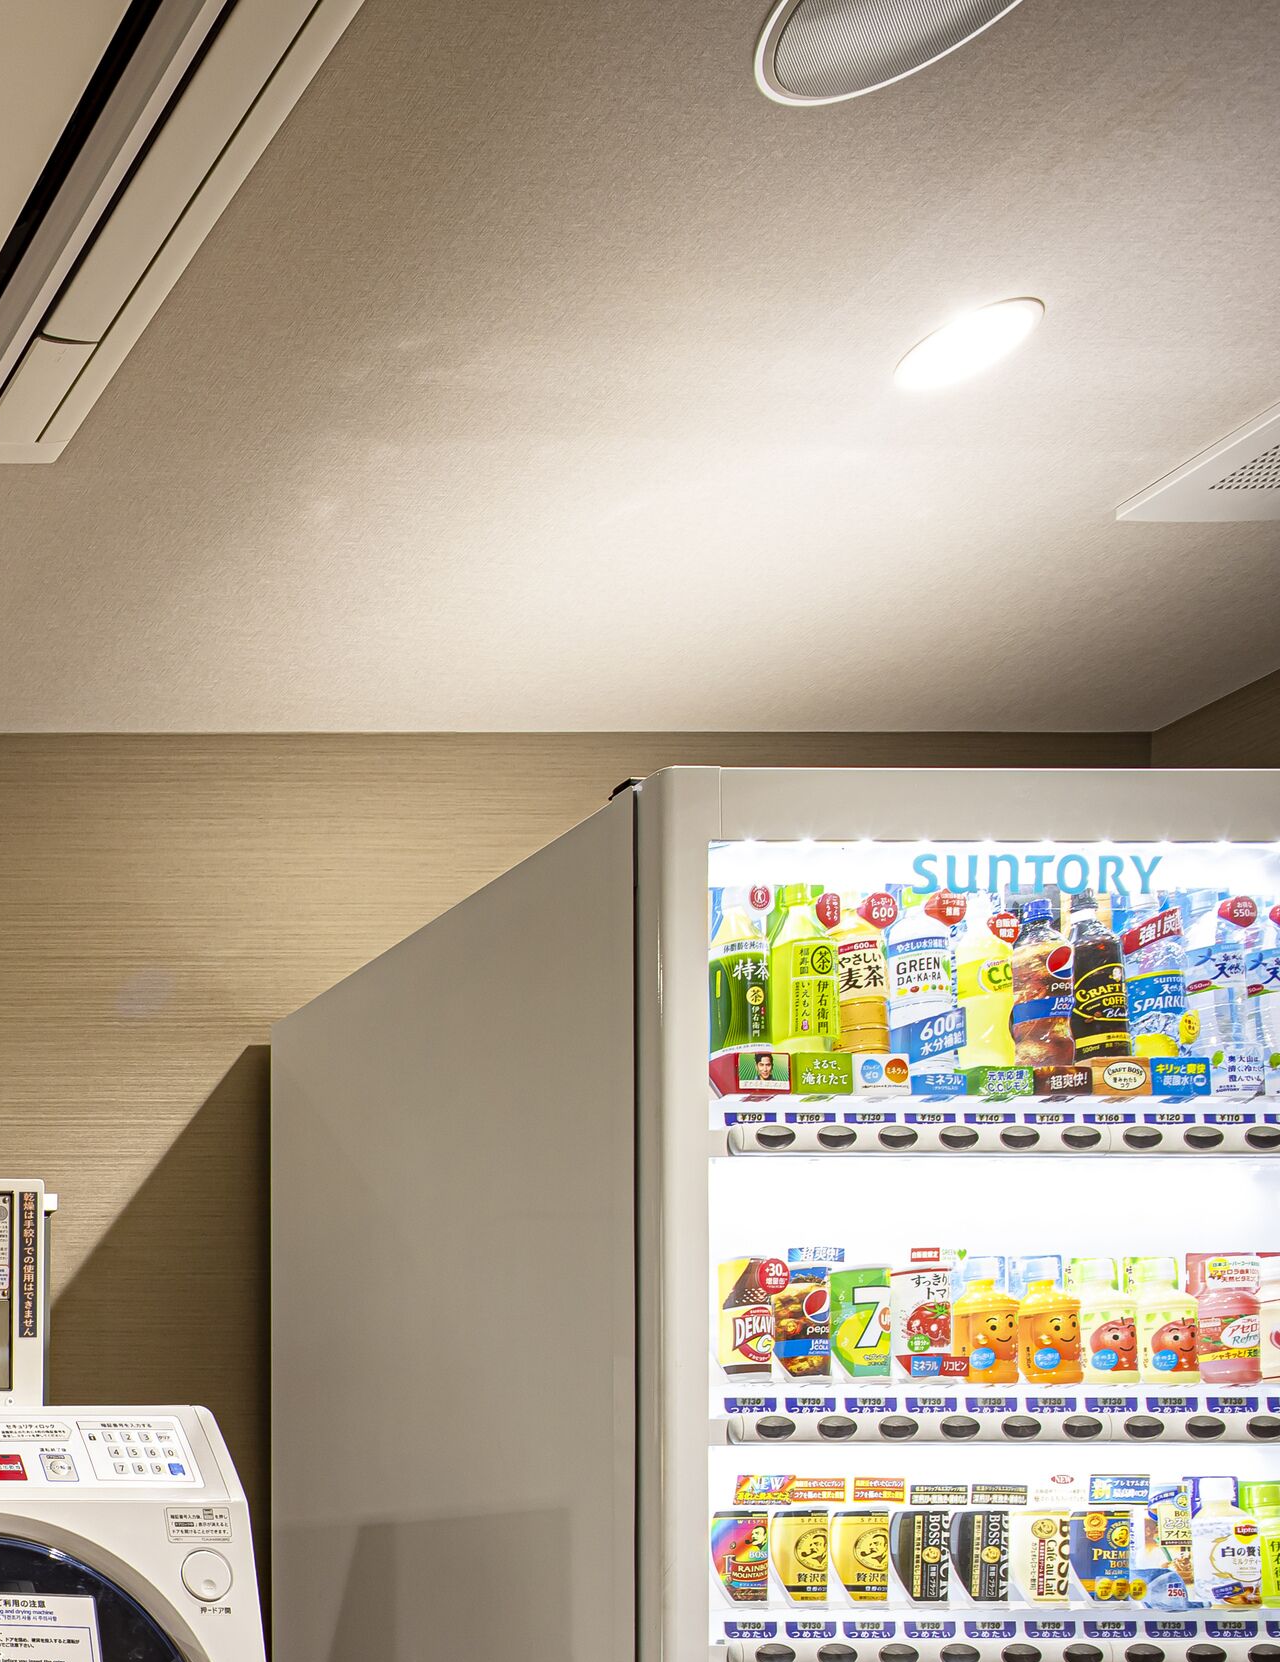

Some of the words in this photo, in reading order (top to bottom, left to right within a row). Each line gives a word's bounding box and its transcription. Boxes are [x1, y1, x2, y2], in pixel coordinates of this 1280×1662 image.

[912, 853, 1164, 895] SUNTORY
[838, 953, 882, 969] やさしい
[896, 957, 940, 975] GREEN
[839, 965, 884, 993] 麦茶
[817, 980, 829, 1035] 伊右衛門
[23, 1192, 34, 1336] 乾燥は手絞りでの使用はできません
[913, 1359, 939, 1371] ミネラル
[943, 1360, 967, 1371] リコピン
[748, 1476, 784, 1491] NEW
[731, 1630, 772, 1638] つめたい
[792, 1630, 833, 1638] つめたい
[1212, 1630, 1253, 1638] つめたい
